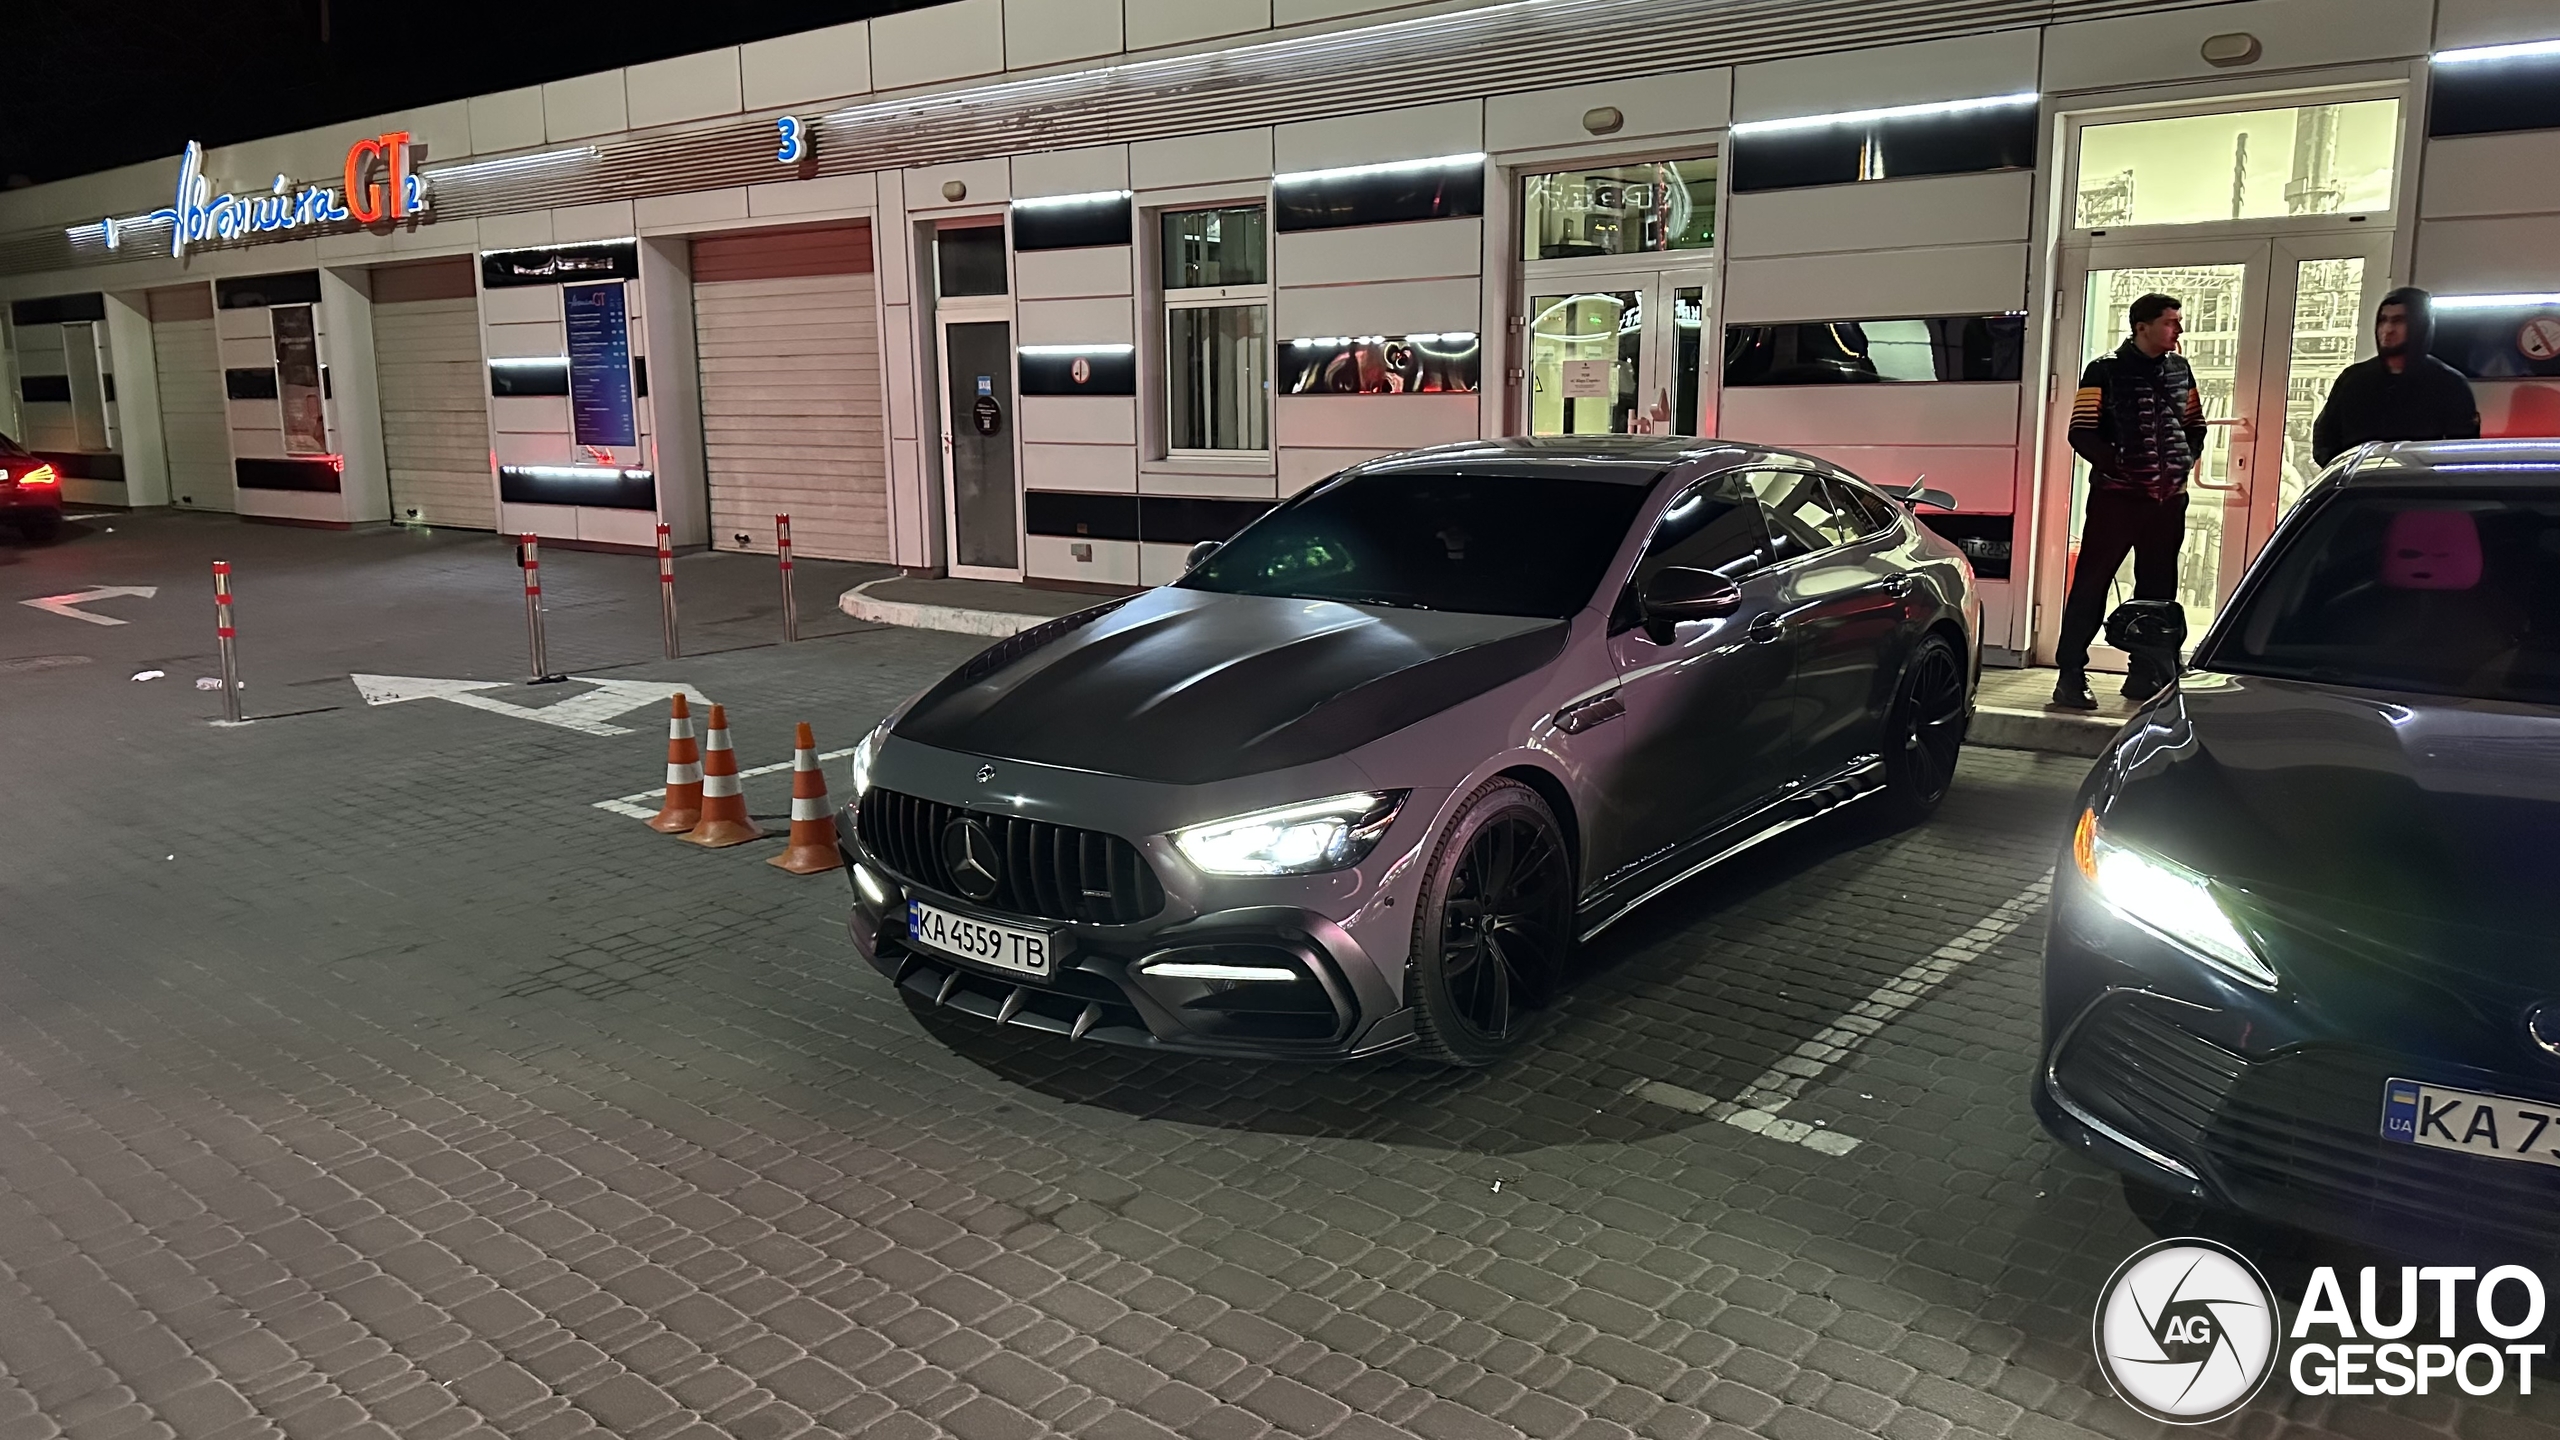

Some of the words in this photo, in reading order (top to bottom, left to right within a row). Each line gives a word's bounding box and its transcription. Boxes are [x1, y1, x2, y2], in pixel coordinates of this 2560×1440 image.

[777, 116, 800, 163] 3
[344, 131, 409, 223] GT
[405, 174, 423, 212] 2
[919, 907, 947, 944] KA
[951, 920, 1002, 959] 4559
[1007, 933, 1045, 968] TB
[2389, 1117, 2413, 1134] UA
[2419, 1095, 2499, 1149] KA
